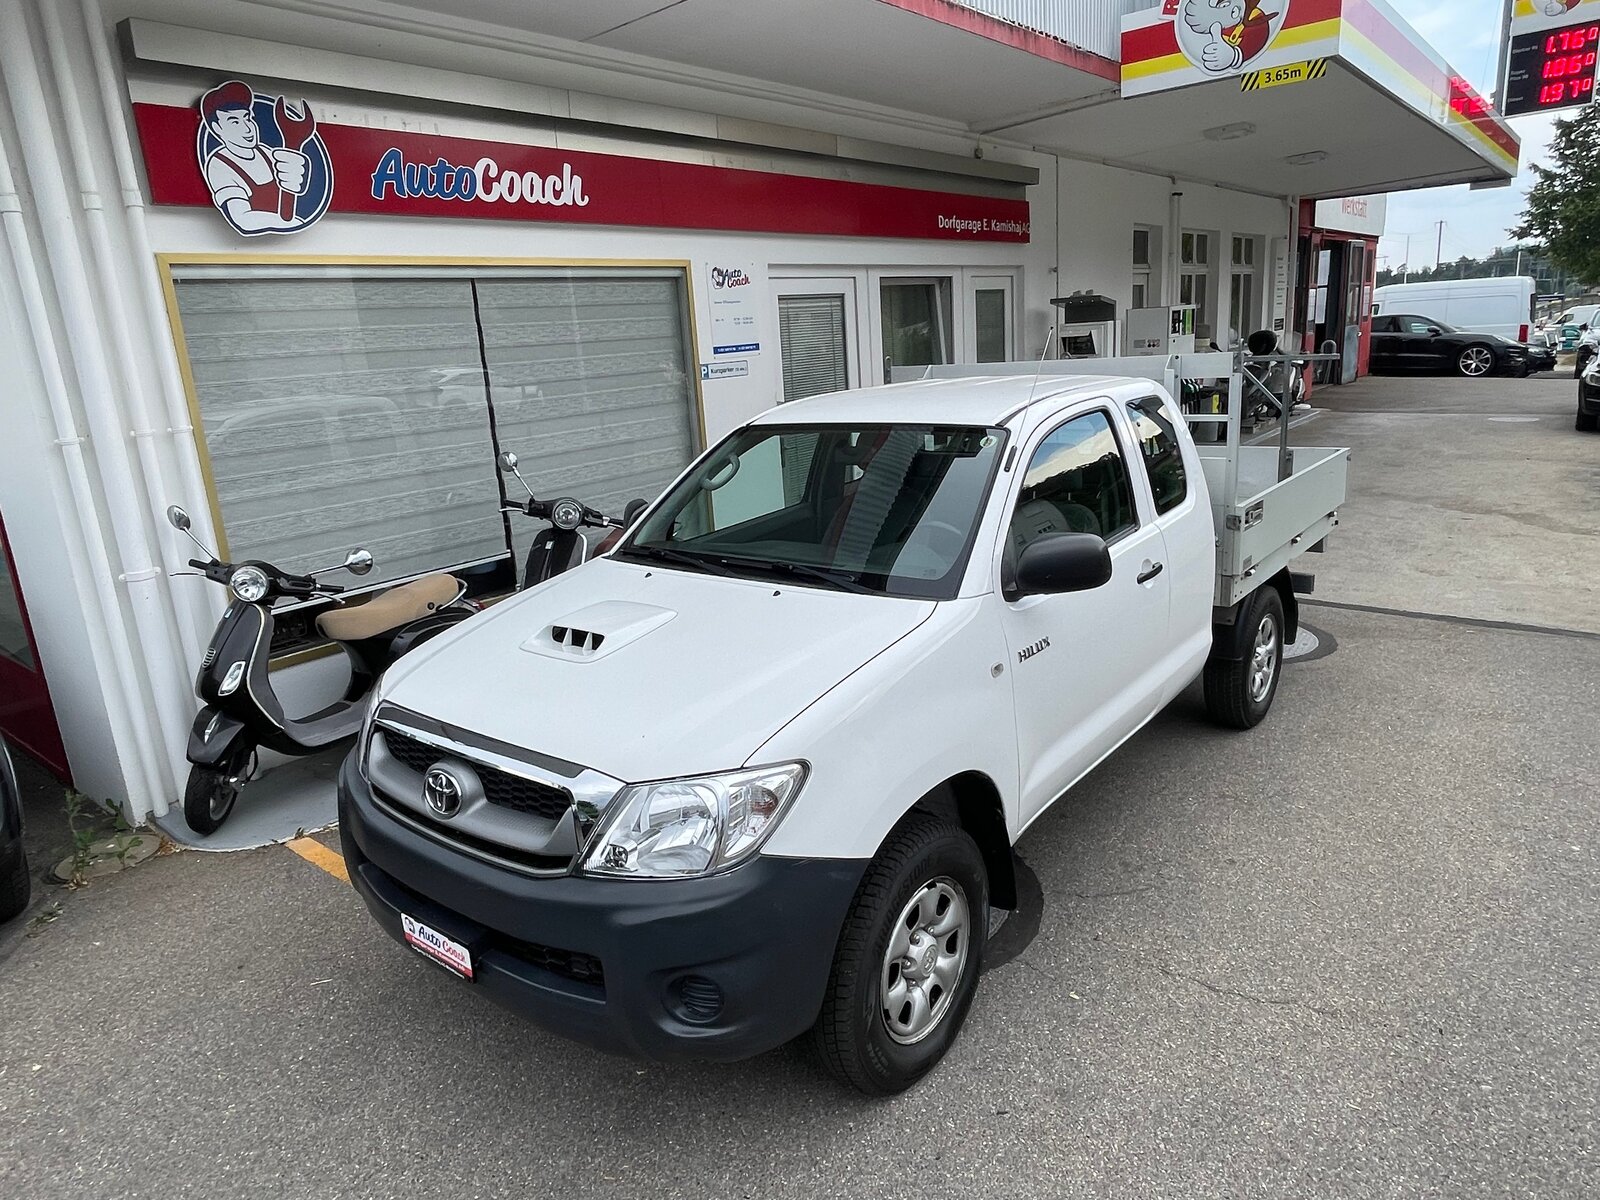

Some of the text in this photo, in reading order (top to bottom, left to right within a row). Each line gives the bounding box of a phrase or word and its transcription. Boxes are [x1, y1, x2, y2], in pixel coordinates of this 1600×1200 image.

[1264, 67, 1302, 84] 3.65m
[938, 214, 982, 234] Dorfgarage
[983, 218, 990, 231] E.
[991, 219, 1022, 236] Kamishaj
[724, 268, 742, 280] Auto
[728, 274, 751, 288] Coach
[1017, 635, 1051, 664] HILUX
[418, 926, 442, 949] Auto
[442, 940, 466, 962] Coach
